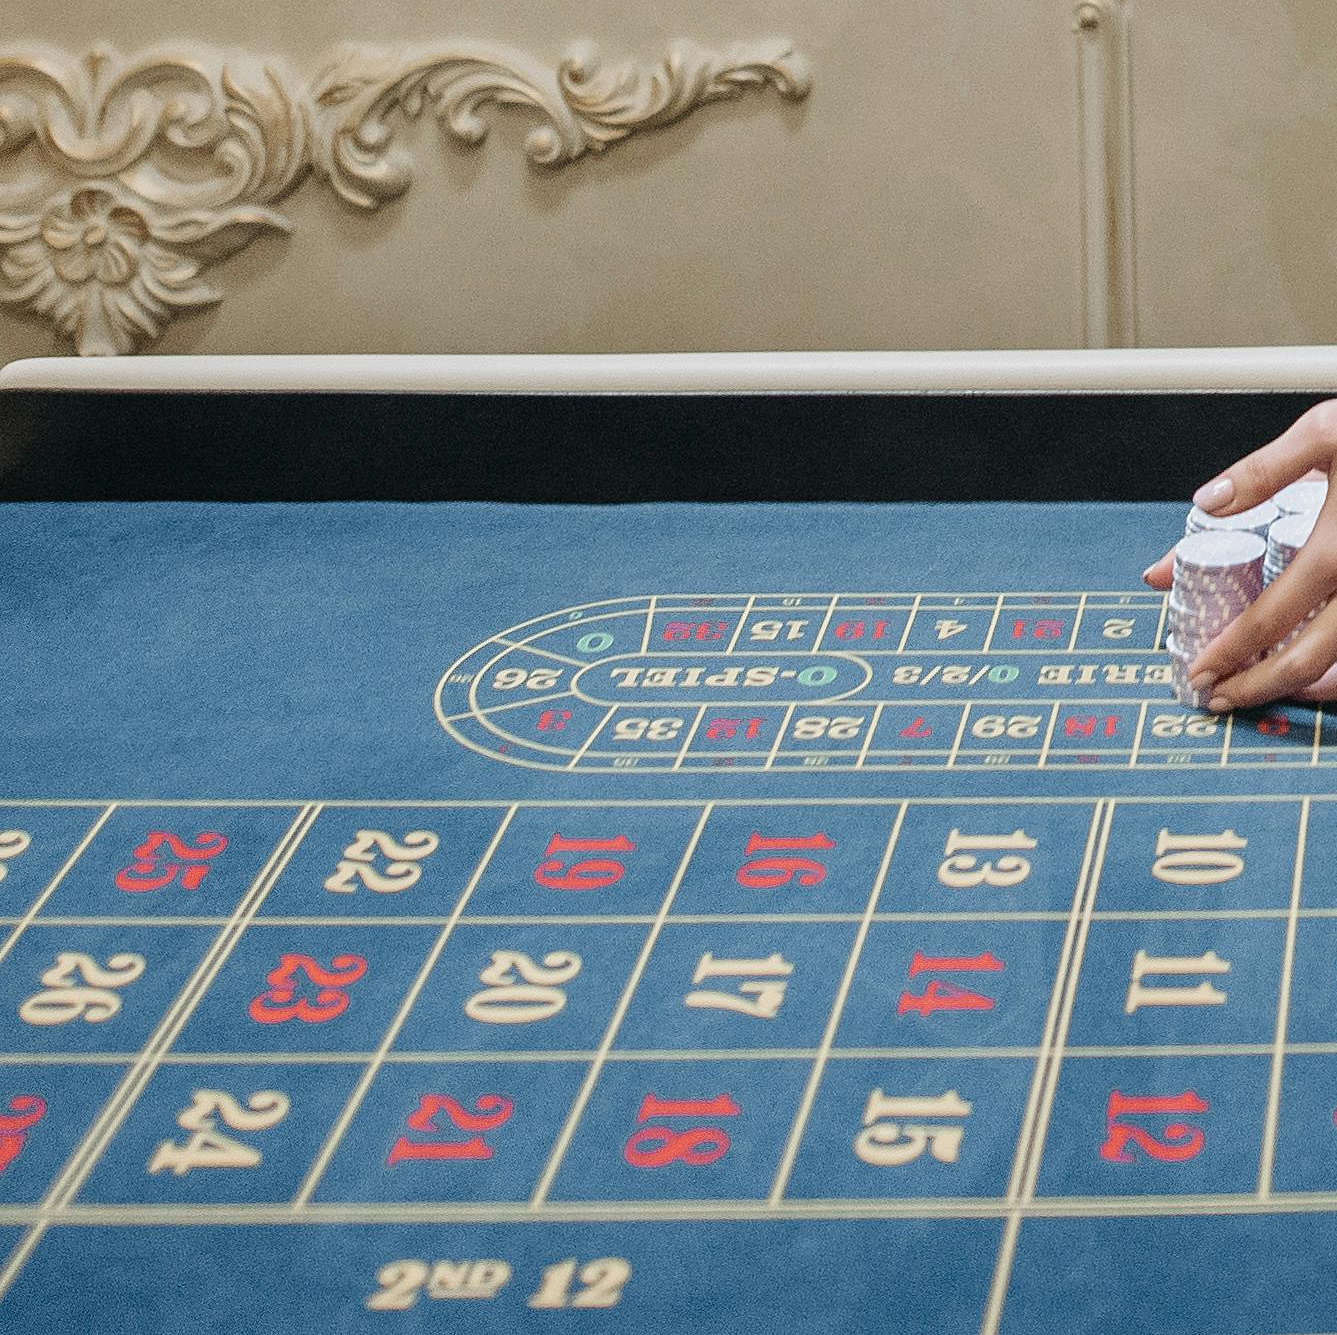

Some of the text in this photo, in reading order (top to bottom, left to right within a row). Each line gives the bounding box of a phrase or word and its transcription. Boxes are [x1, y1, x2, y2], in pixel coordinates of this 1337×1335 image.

[576, 632, 614, 653] 0
[663, 622, 726, 641] 32
[751, 620, 808, 641] 15
[835, 621, 886, 639] 19
[935, 620, 966, 640] 4
[1013, 620, 1063, 638] 21
[1103, 619, 1134, 639] 2
[490, 667, 563, 691] 26
[610, 666, 839, 688] 0-SPIEL
[892, 665, 1173, 686] ERIE 0/2/3
[537, 710, 572, 731] 3
[614, 718, 683, 741] 35
[705, 717, 766, 739] 12
[793, 716, 865, 740] 28
[900, 717, 932, 738] 7
[972, 715, 1041, 738] 29
[1065, 716, 1118, 736] 18
[1152, 714, 1220, 737] 22
[115, 831, 227, 892] 25
[323, 830, 439, 894] 22
[534, 834, 634, 890] 19
[737, 833, 834, 888] 16
[937, 829, 1037, 888] 13
[1151, 829, 1248, 885] 10
[18, 952, 146, 1026] 26
[249, 954, 367, 1023] 23
[464, 950, 582, 1024] 20
[684, 953, 793, 1019] 17
[898, 952, 1003, 1016] 14
[1124, 950, 1230, 1014] 11
[148, 1089, 290, 1176] 24
[388, 1095, 512, 1164] 21
[625, 1095, 739, 1167] 18
[853, 1089, 971, 1166] 15
[1100, 1091, 1208, 1161] 12
[367, 1257, 631, 1311] 2ND 12
